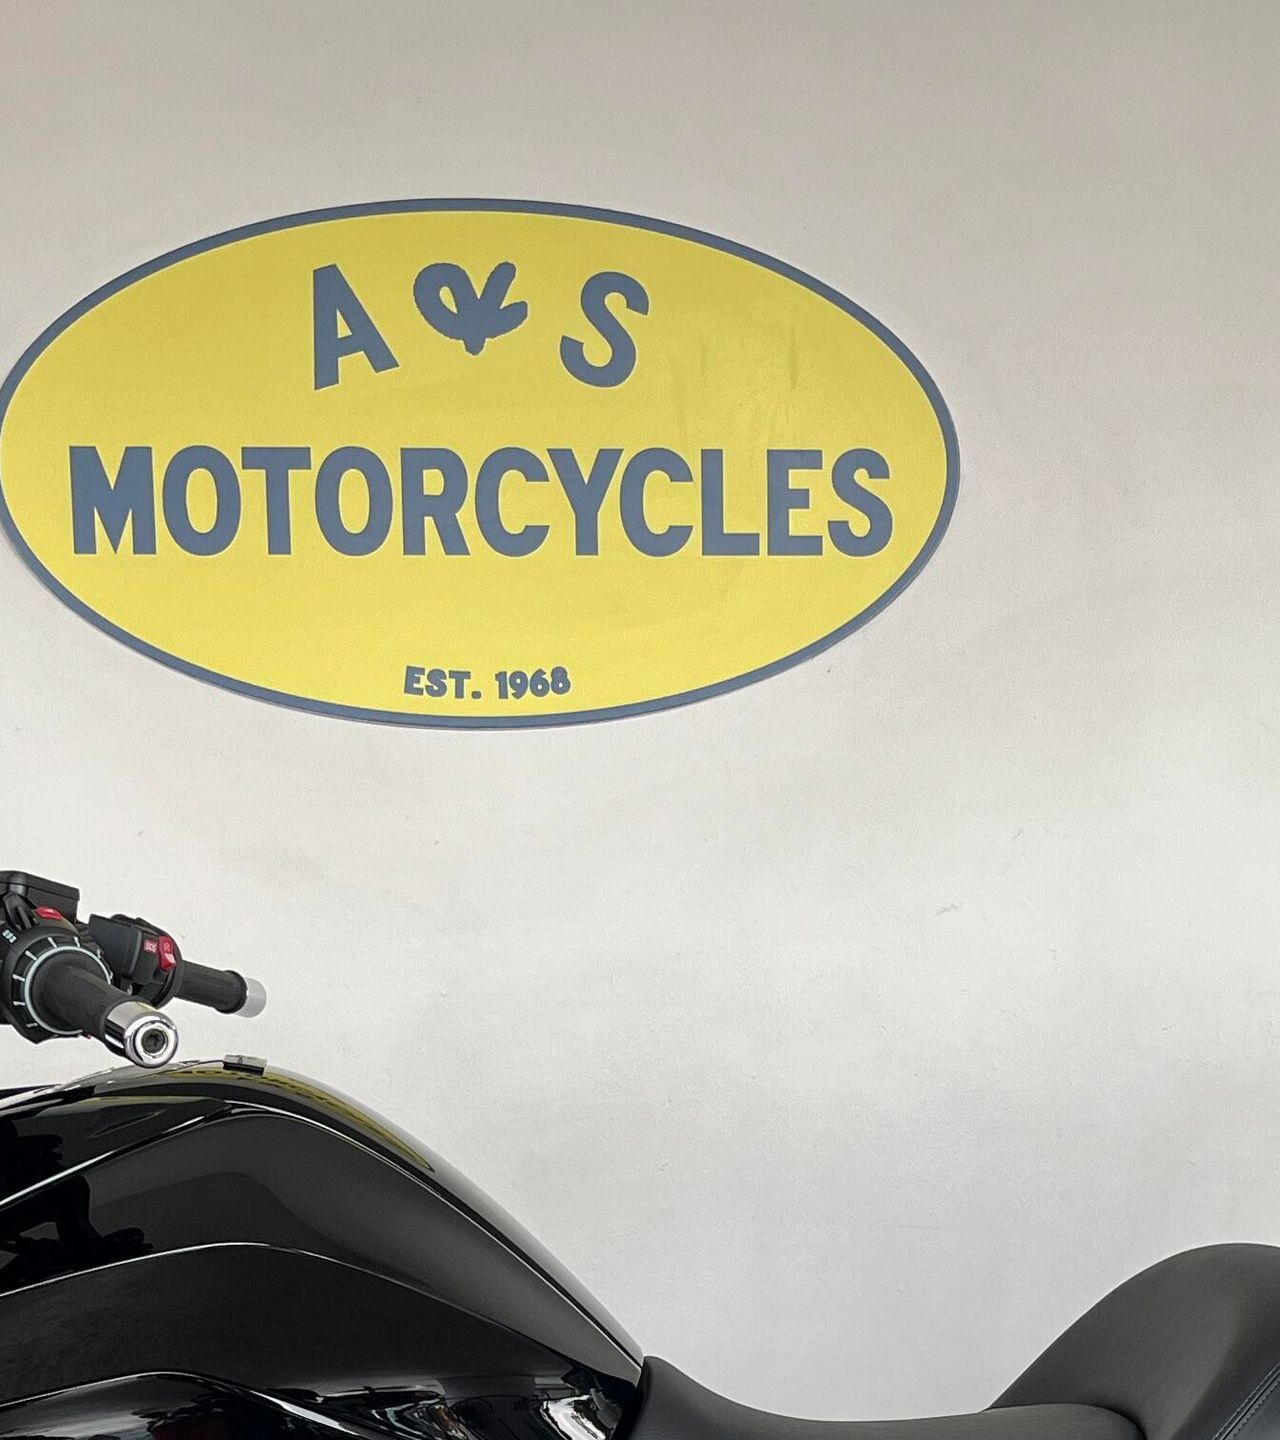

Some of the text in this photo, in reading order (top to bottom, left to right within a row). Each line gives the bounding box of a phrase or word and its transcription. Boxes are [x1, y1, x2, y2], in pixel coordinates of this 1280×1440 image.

[313, 262, 650, 391] A & S
[69, 445, 894, 557] MOTORCYCLES
[404, 666, 572, 701] EST. 1968
